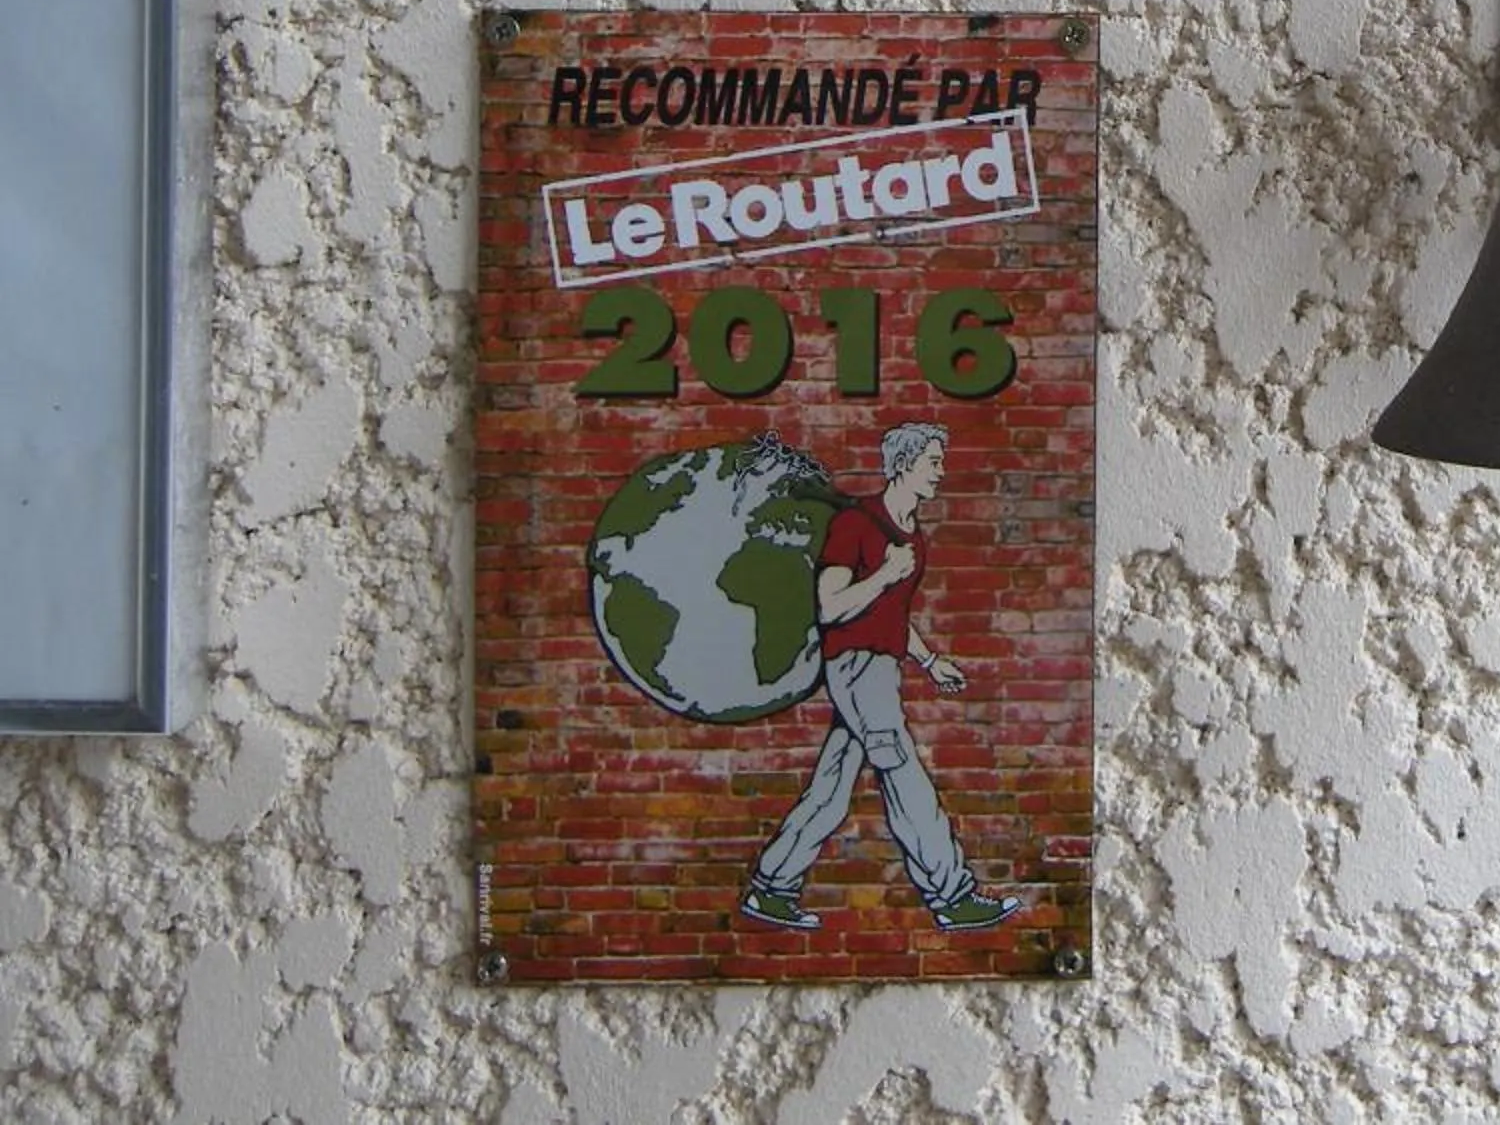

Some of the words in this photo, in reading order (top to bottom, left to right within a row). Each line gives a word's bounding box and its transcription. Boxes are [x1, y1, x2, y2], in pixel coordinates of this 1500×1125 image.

[547, 55, 923, 127] RECOMMANDÉ
[934, 67, 1042, 126] PAR
[574, 284, 1018, 400] 2016
